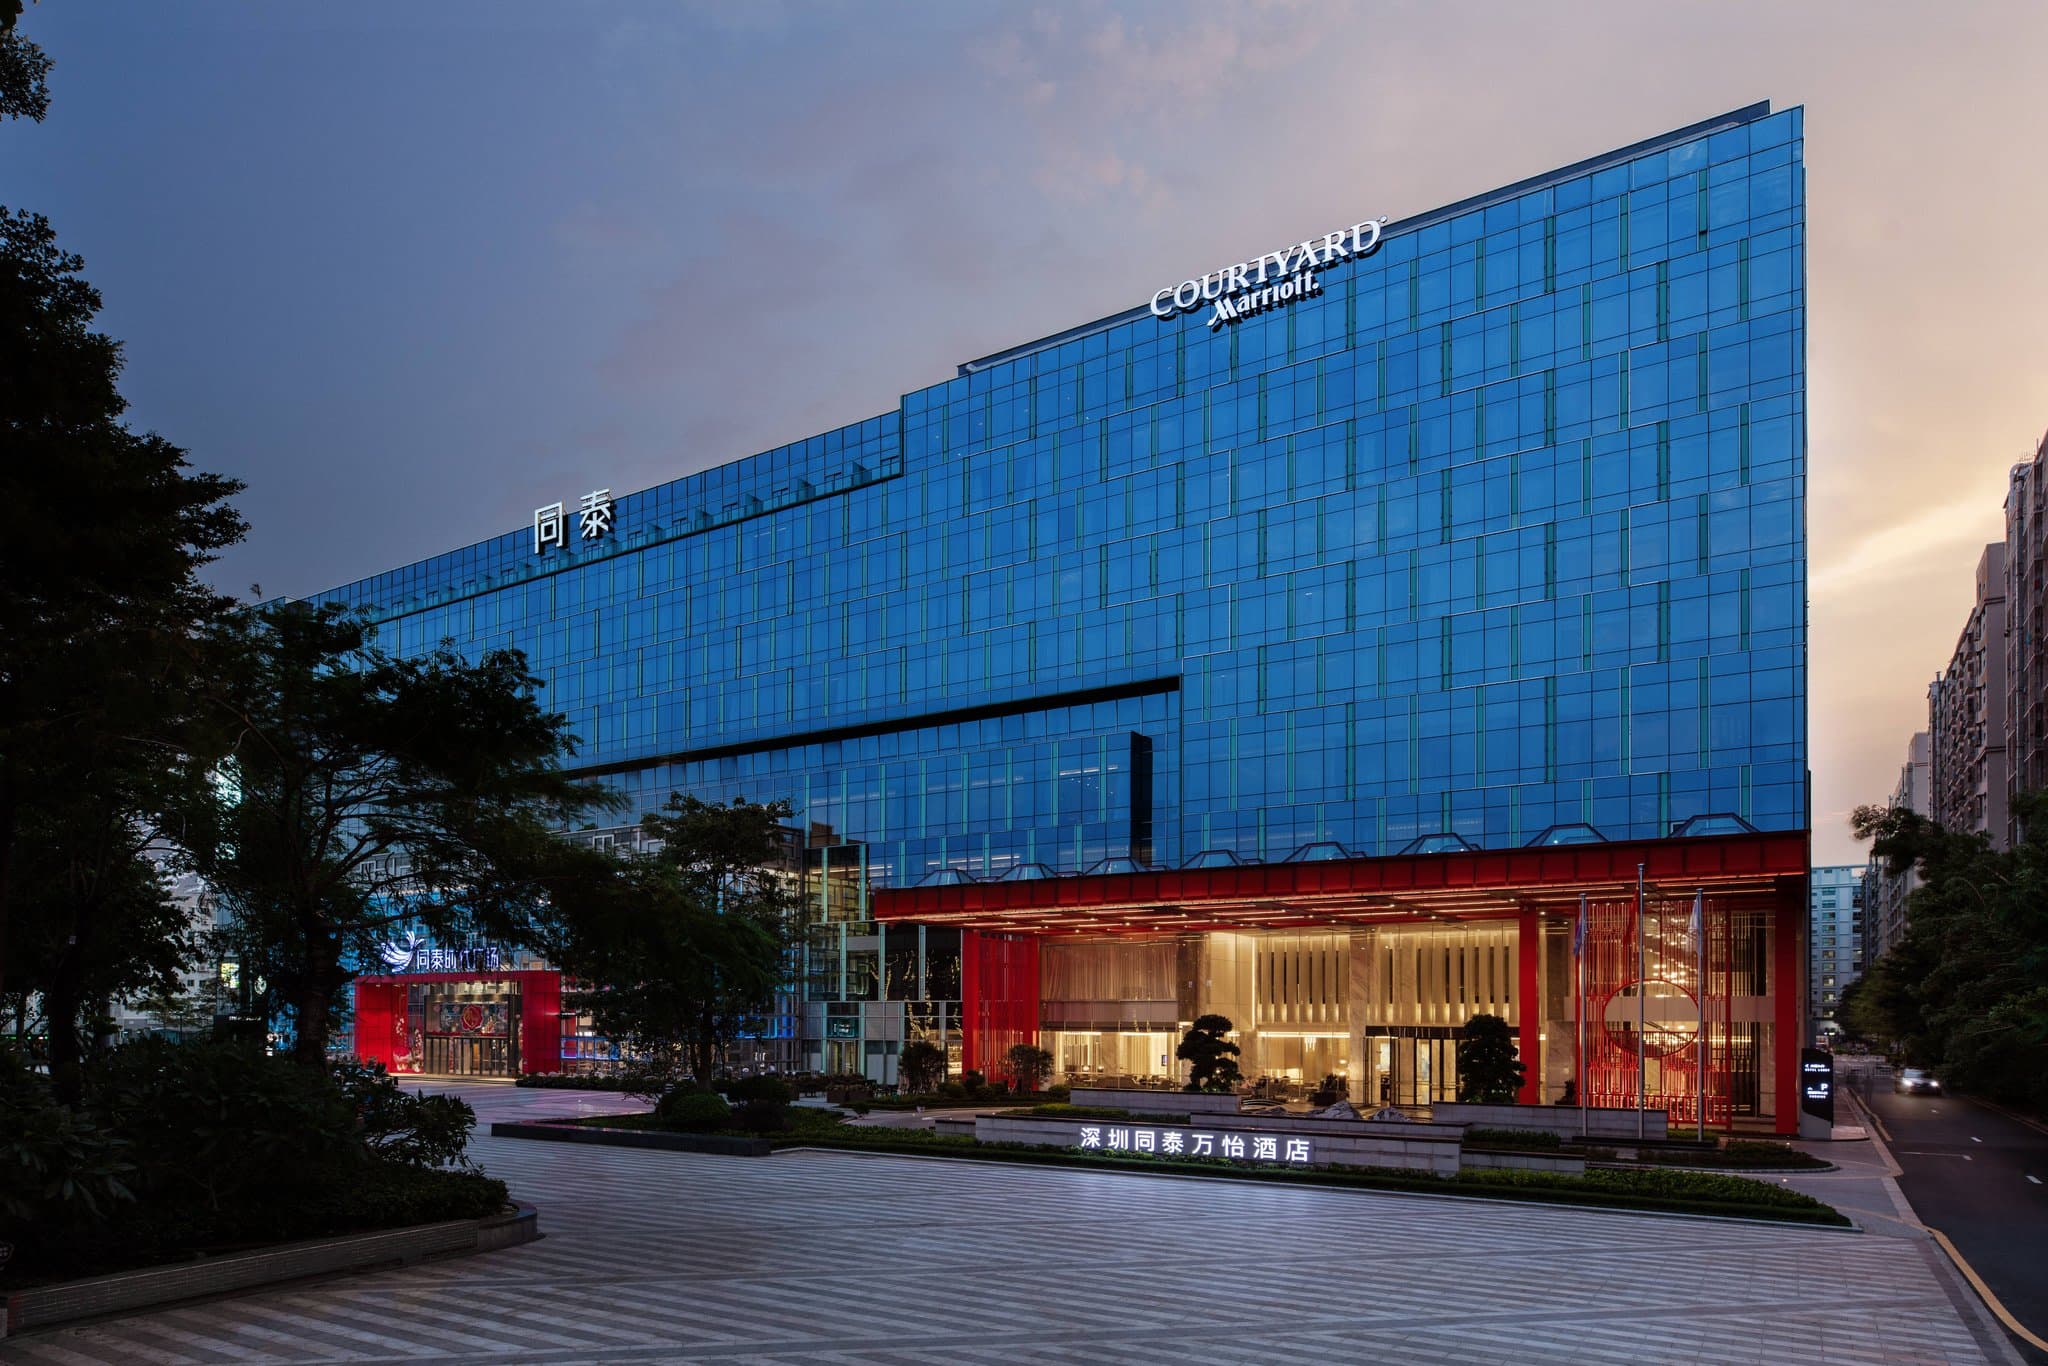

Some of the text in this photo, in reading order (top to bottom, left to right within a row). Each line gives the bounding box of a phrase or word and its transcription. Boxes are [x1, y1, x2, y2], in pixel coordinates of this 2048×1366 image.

[1151, 219, 1382, 316] COURTYARD
[1207, 270, 1313, 326] Marriott
[535, 488, 611, 554] 同泰
[1080, 1127, 1311, 1162] 深圳同泰万怡酒店
